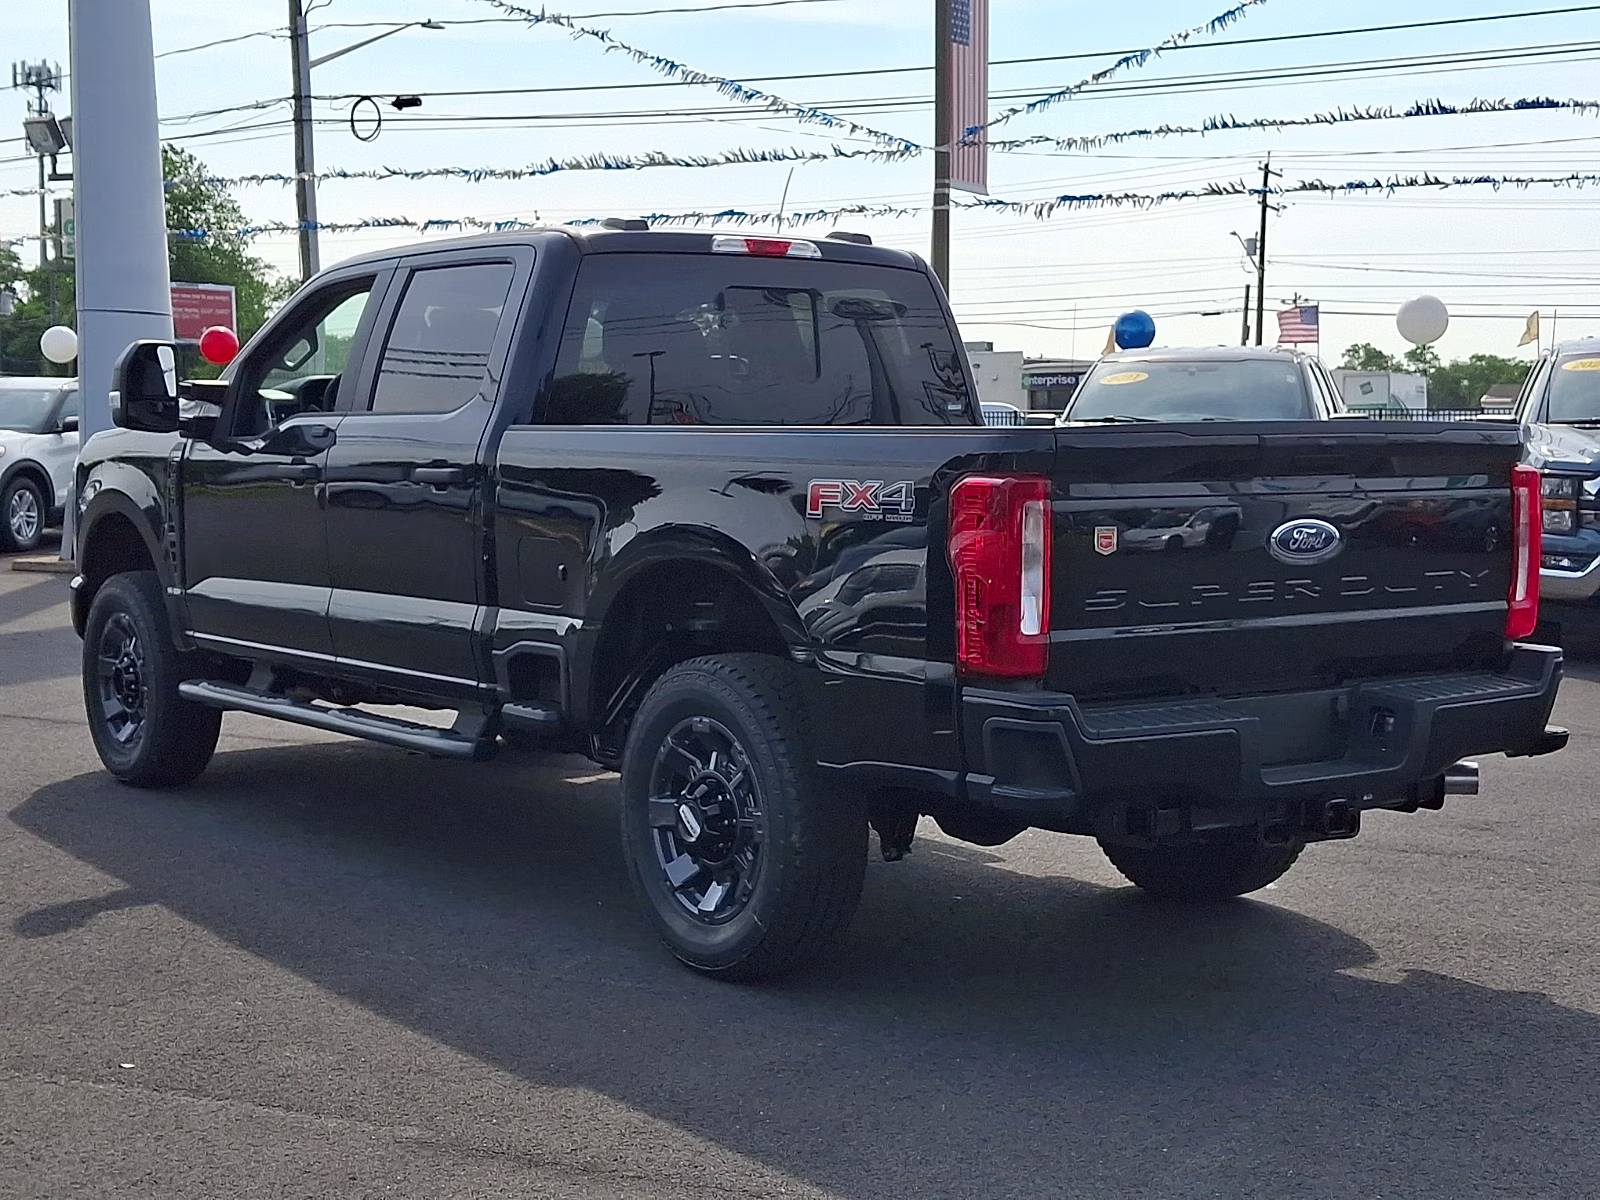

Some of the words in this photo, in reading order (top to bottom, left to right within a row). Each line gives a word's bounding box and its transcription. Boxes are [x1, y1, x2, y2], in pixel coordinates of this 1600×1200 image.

[1023, 374, 1076, 387] enterprise
[806, 479, 915, 518] FX4
[1289, 527, 1326, 550] Ford
